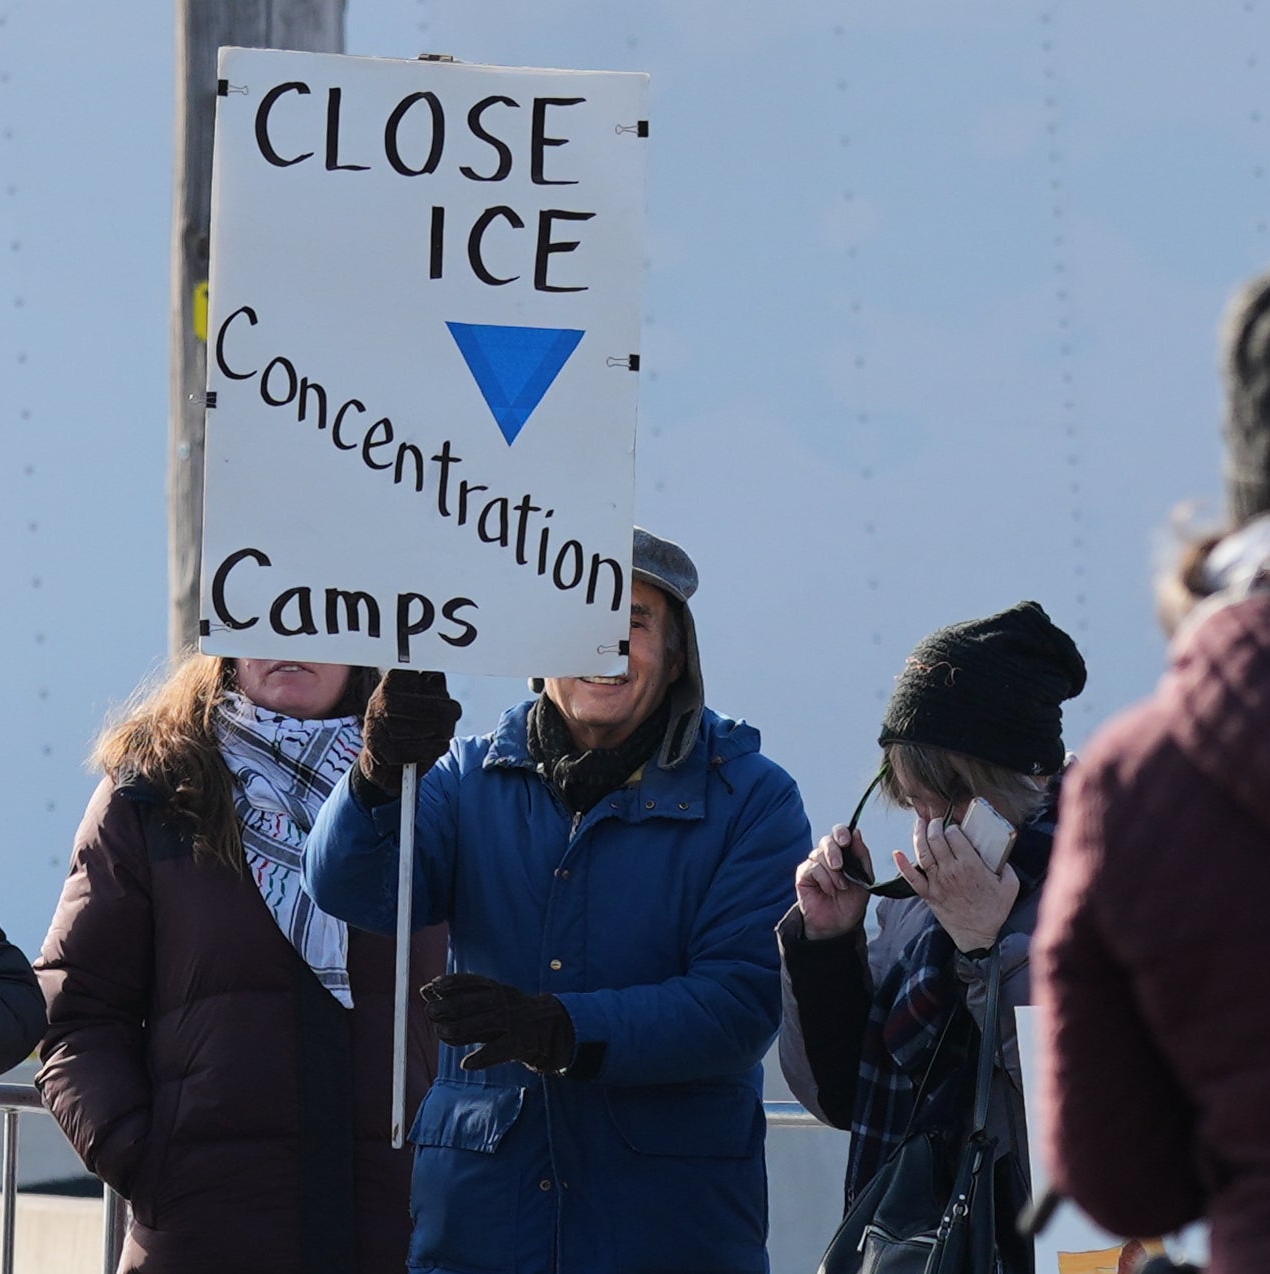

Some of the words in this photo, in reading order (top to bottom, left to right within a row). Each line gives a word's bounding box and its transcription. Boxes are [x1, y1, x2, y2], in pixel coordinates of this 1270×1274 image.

[254, 80, 587, 186] CLOSE
[428, 204, 597, 293] ICE
[215, 305, 625, 612] Concentration
[211, 547, 479, 664] Camps
